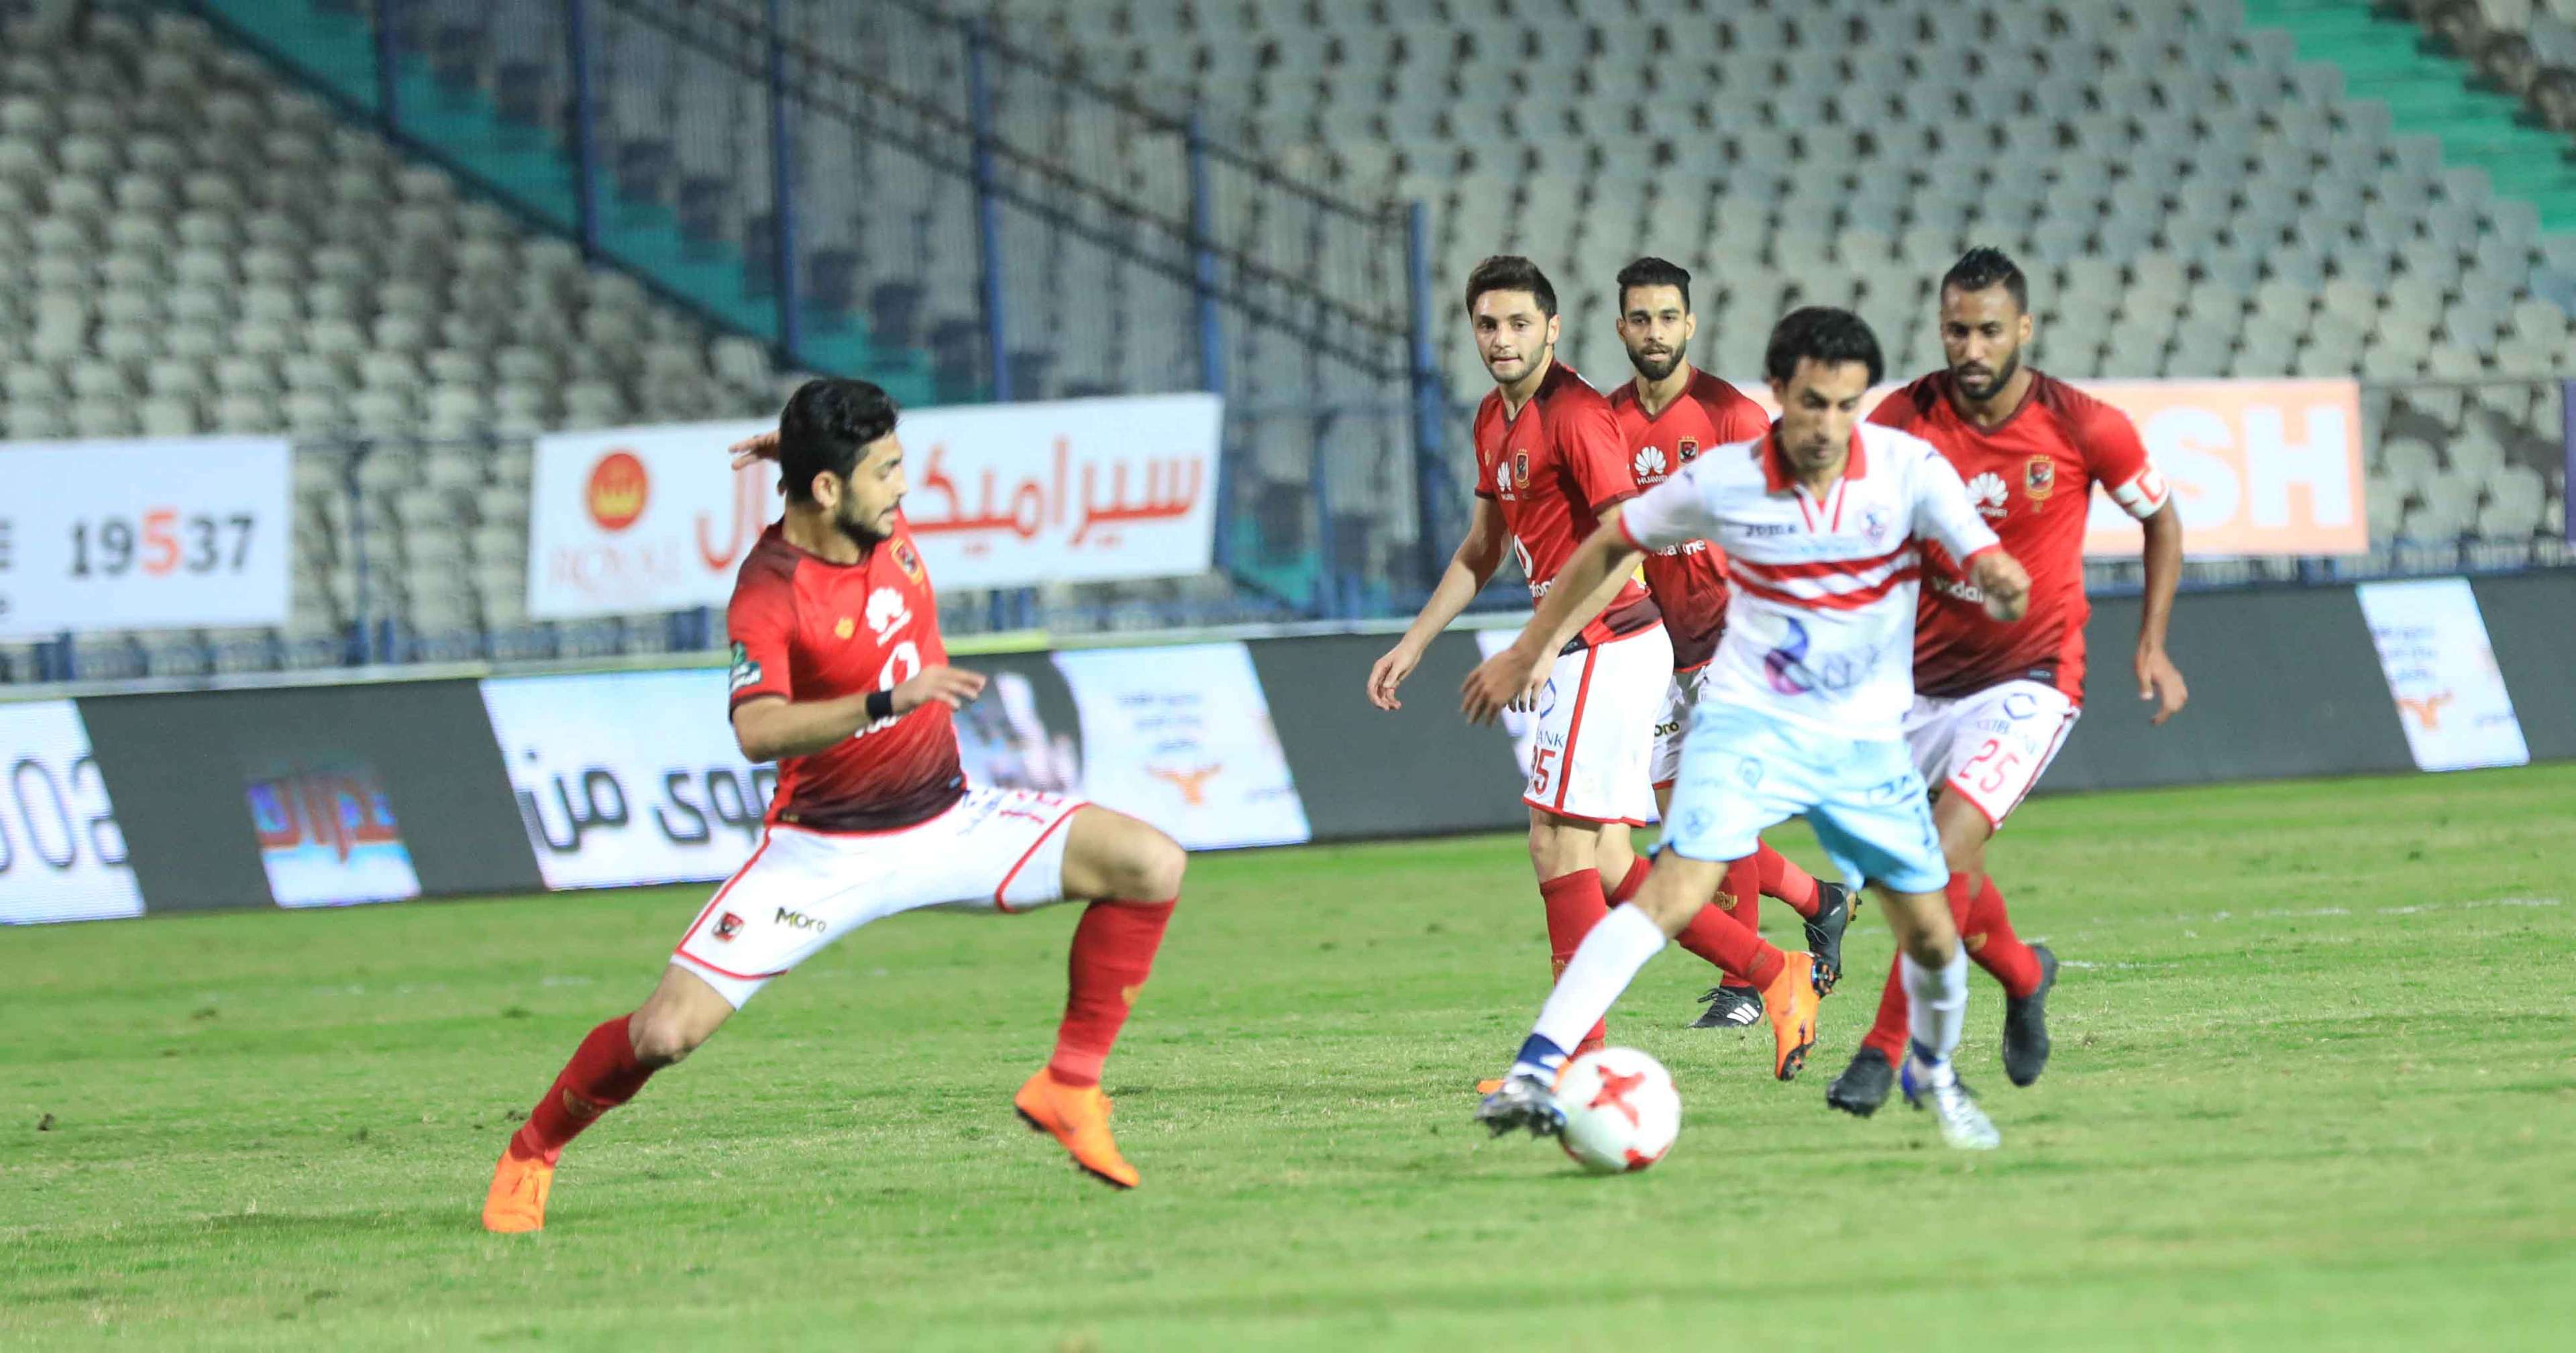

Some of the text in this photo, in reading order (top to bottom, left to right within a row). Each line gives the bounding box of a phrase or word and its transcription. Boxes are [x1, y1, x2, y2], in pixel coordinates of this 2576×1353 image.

[908, 435, 1203, 556] سيراميك
[2088, 405, 2353, 531] SH
[70, 508, 255, 578] 19537
[1538, 730, 1564, 748] ANK
[1959, 739, 2020, 794] 25
